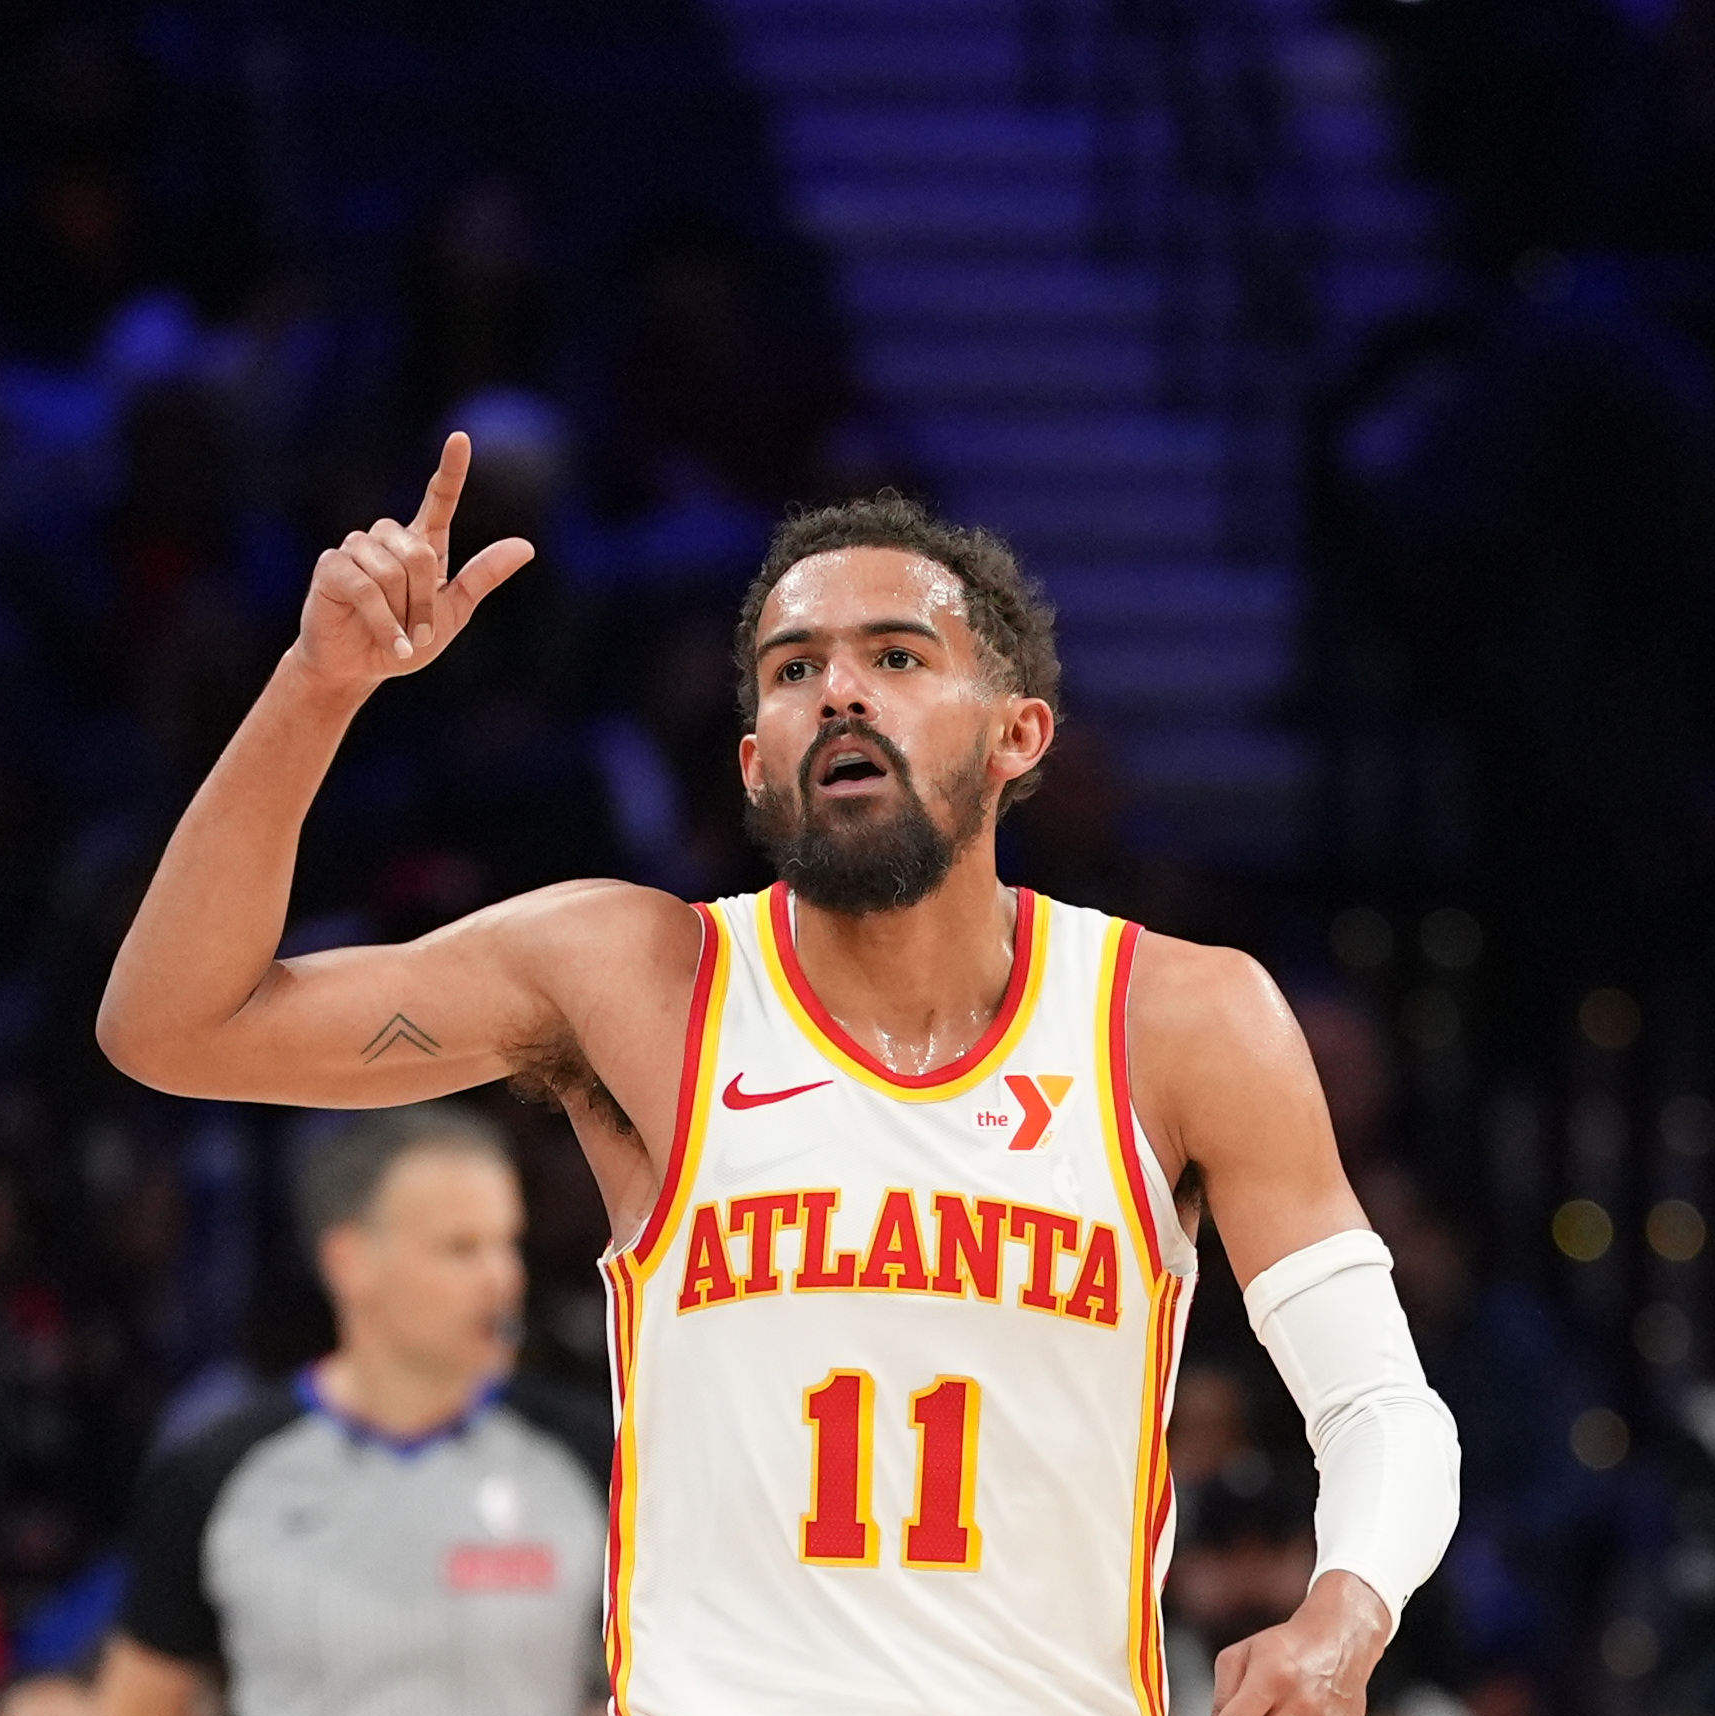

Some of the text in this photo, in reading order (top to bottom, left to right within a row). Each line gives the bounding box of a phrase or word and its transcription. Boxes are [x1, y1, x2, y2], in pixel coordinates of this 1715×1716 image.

[977, 1111, 1009, 1127] the
[676, 1187, 1124, 1330] ATLANTA
[799, 1368, 982, 1573] 11
